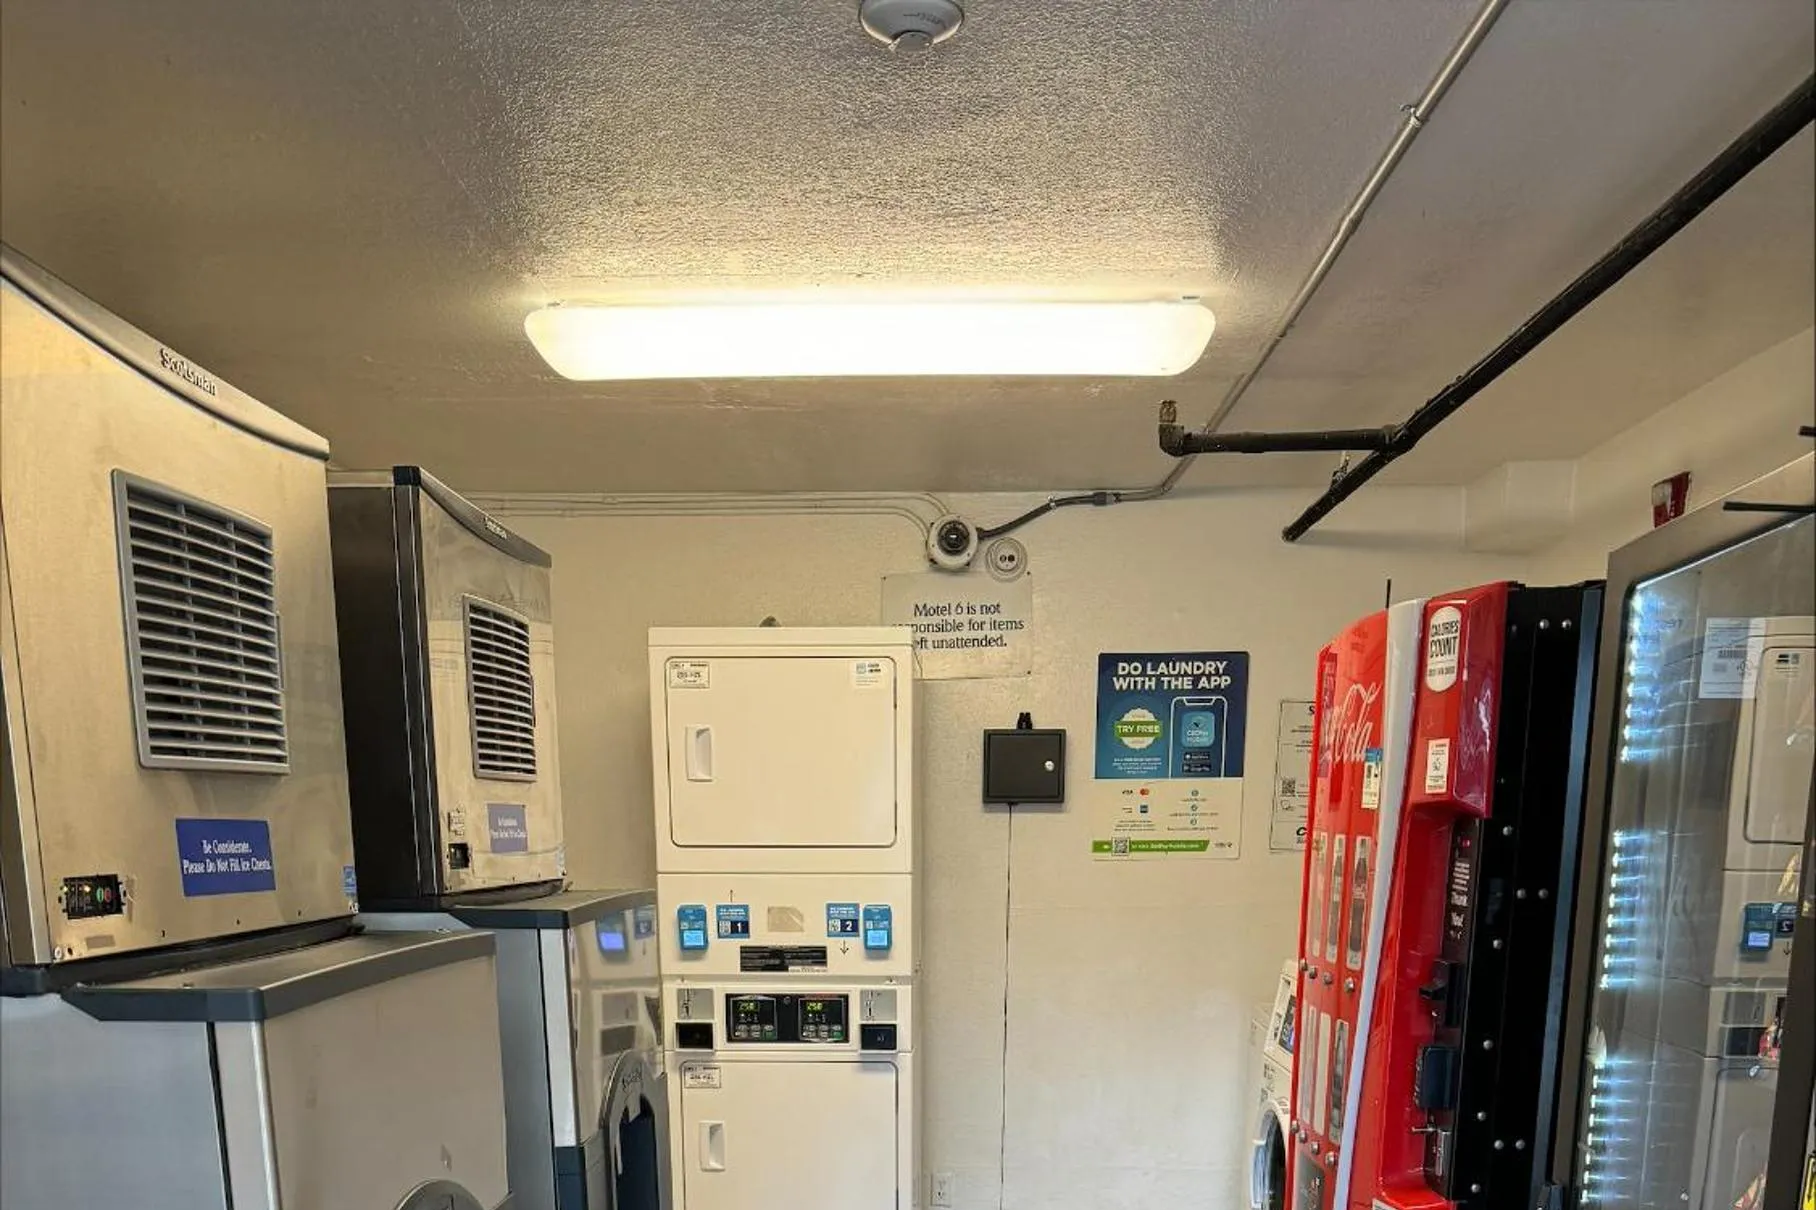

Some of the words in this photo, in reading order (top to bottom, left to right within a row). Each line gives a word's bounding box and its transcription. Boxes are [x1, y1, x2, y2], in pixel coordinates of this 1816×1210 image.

[160, 348, 217, 397] Scotsman
[913, 602, 951, 617] Motel
[954, 602, 964, 616] 6
[967, 602, 977, 616] is
[980, 602, 1002, 616] not
[893, 618, 964, 633] ponsible
[968, 618, 986, 632] for
[989, 617, 1025, 631] items
[932, 634, 1008, 649] unattended.
[1117, 661, 1142, 675] DO
[1146, 661, 1228, 675] LAUNDRY
[1112, 676, 1156, 690] WITH
[1161, 676, 1193, 690] THE
[1198, 675, 1231, 690] APP
[1116, 725, 1134, 734] TRY
[1136, 725, 1161, 734] FREE
[736, 921, 742, 933] 1
[845, 920, 853, 932] 2
